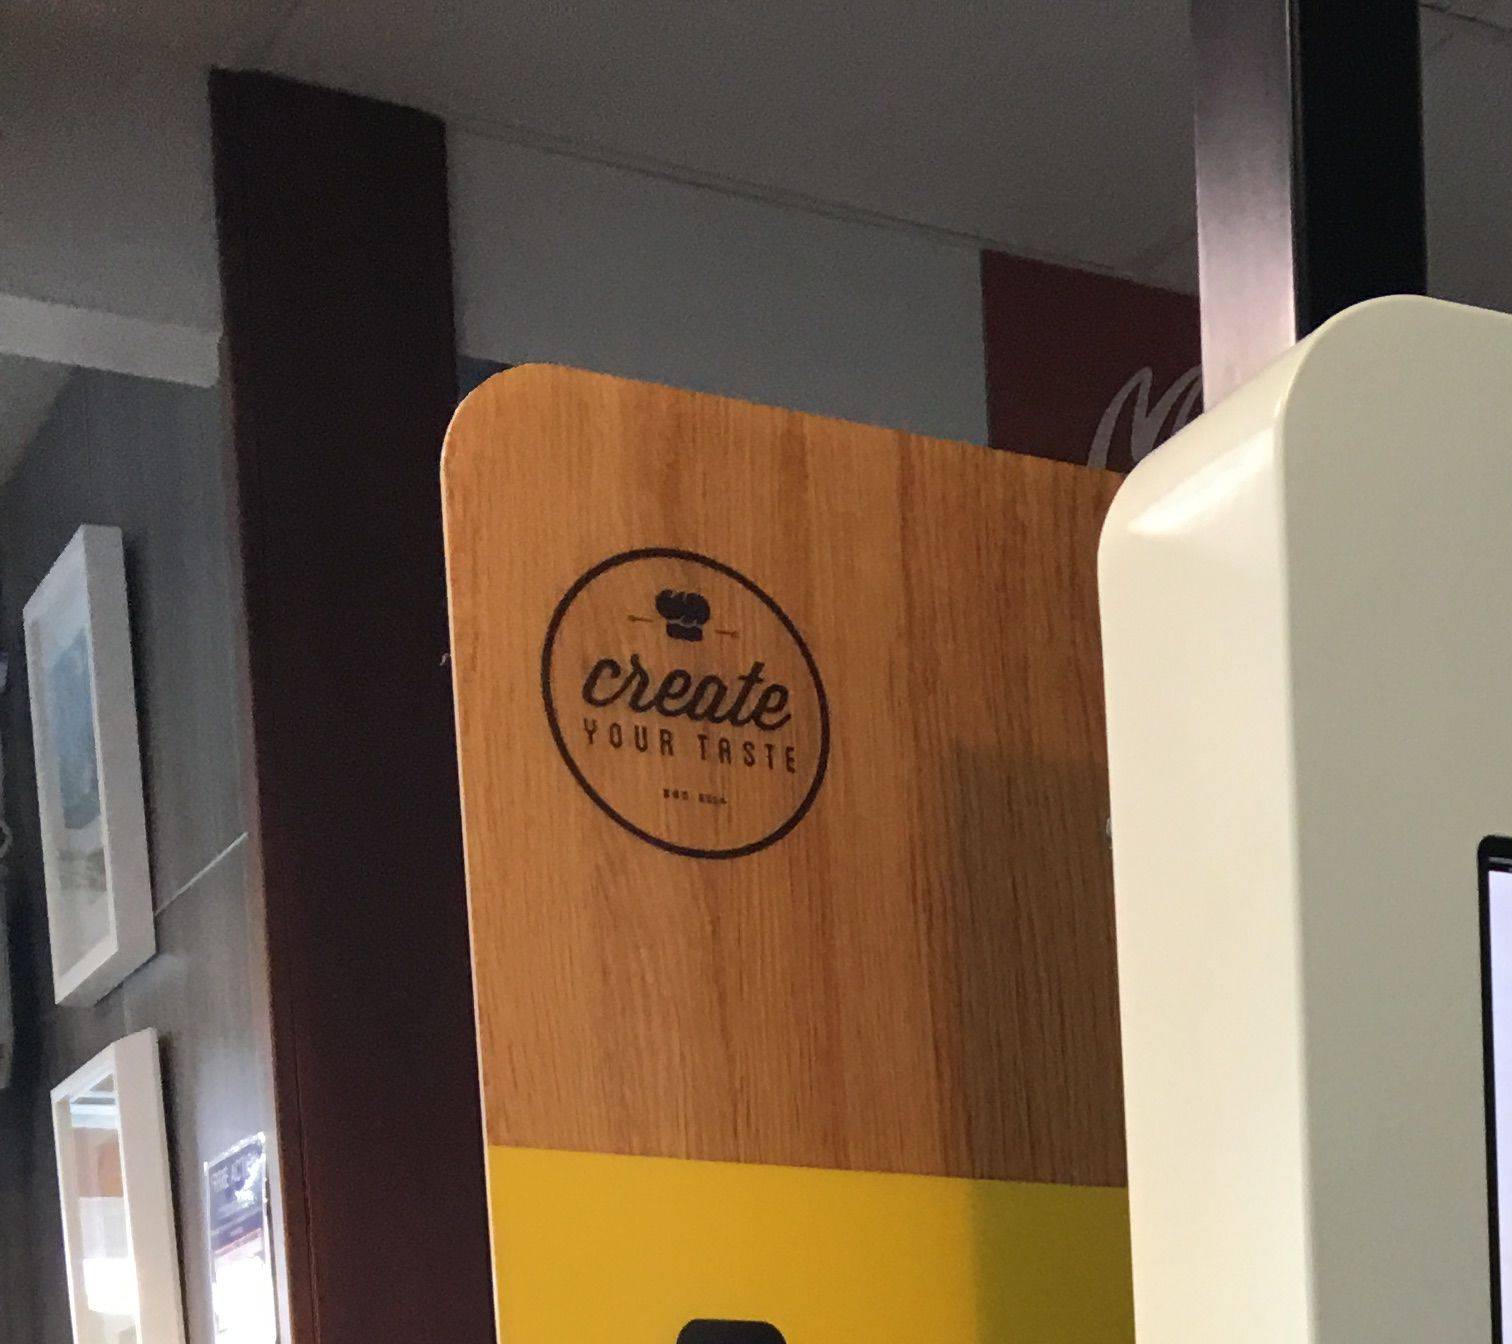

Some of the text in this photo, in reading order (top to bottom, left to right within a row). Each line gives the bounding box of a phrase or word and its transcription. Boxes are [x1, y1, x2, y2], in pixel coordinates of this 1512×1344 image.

[582, 653, 792, 731] create
[583, 718, 796, 774] YOUR TASTE
